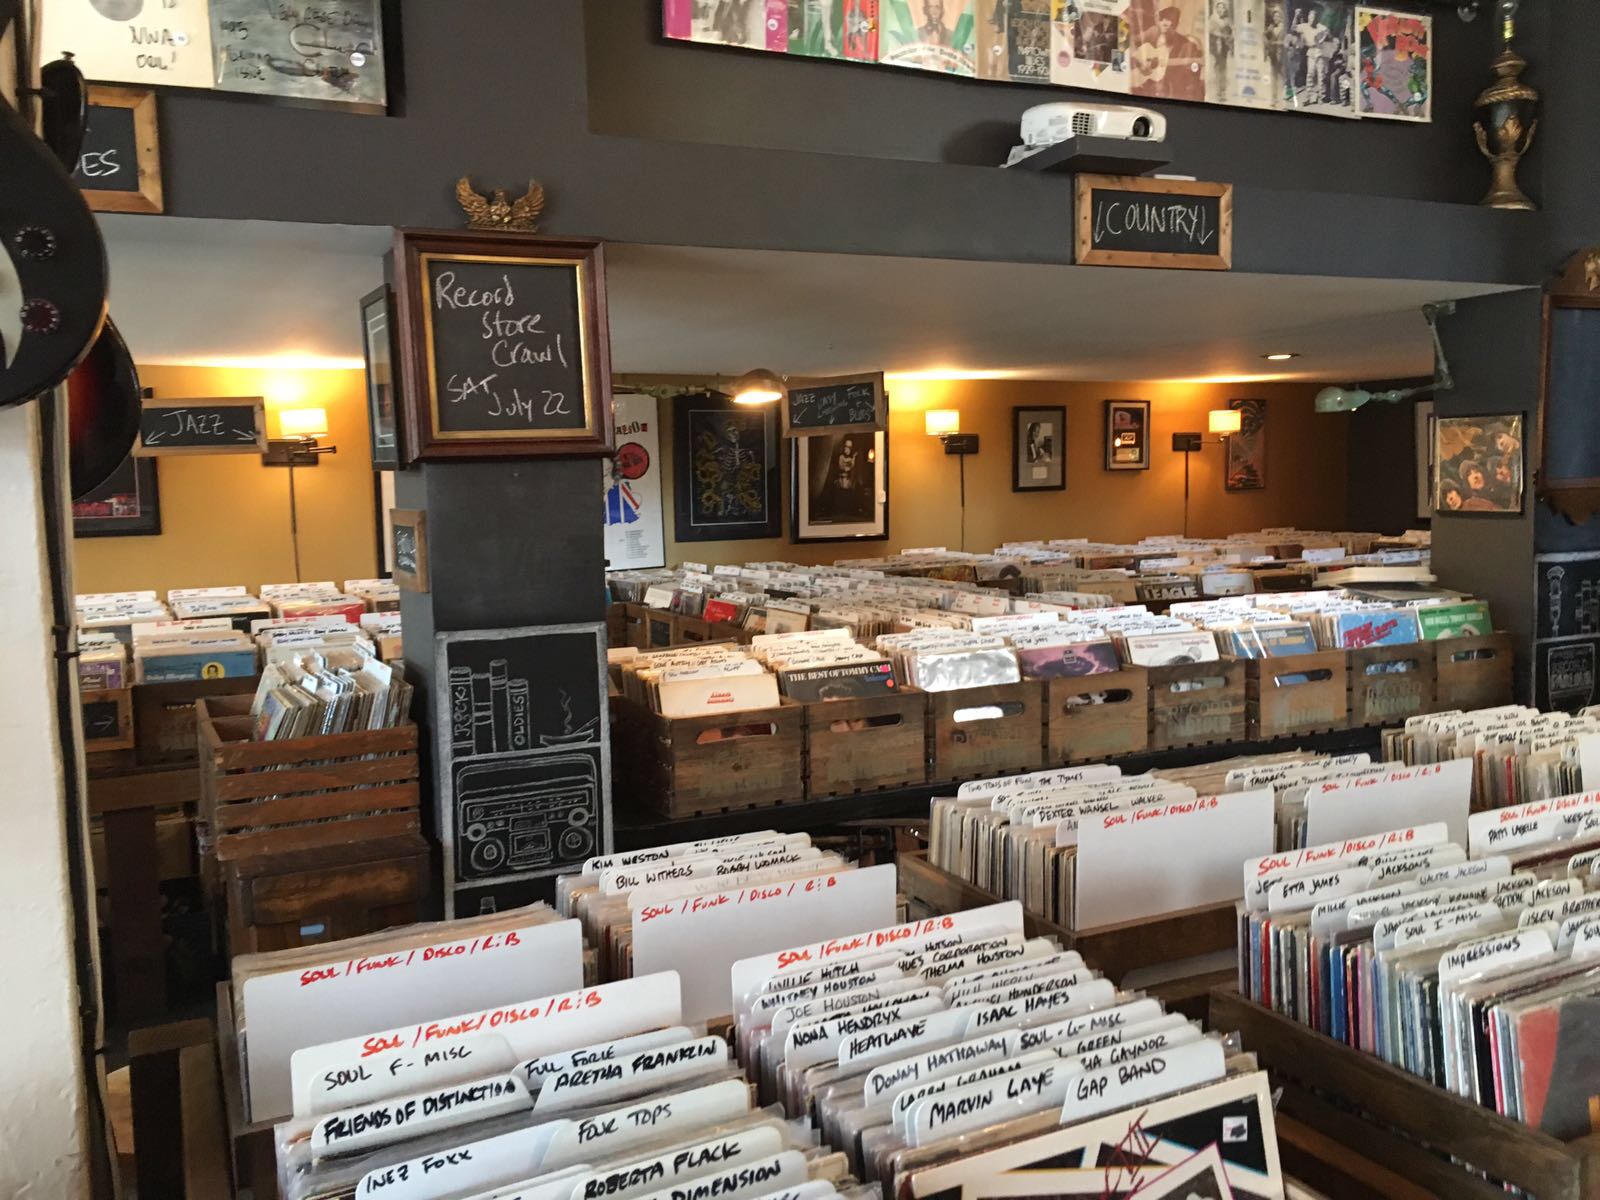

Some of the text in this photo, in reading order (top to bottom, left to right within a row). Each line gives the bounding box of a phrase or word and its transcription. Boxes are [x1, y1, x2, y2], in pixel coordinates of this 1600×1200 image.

[73, 149, 120, 177] ES
[1106, 201, 1198, 242] COUNTRY
[435, 271, 515, 309] Record
[492, 333, 569, 368] Crawl
[488, 388, 571, 423] July 22
[162, 409, 226, 438] JAZZ
[1144, 585, 1198, 600] LEAGUE
[788, 664, 891, 682] THE BEST OF TOMMY CA
[513, 695, 526, 746] OLDIES
[1039, 802, 1119, 823] DEXTER WANSEL
[591, 849, 670, 871] KIM WESTON
[1257, 858, 1292, 877] SOUL
[1305, 849, 1336, 863] FUNK
[1346, 839, 1376, 853] DISCO
[1377, 858, 1432, 880] JACKSONS
[1453, 864, 1488, 881] JACKSON
[615, 864, 693, 889] BILL WITHERS
[1282, 882, 1305, 898] ETTA
[1308, 873, 1340, 894] JAMES
[640, 904, 674, 922] SOUL
[691, 895, 730, 912] FUNK
[749, 885, 782, 902] DISCO
[1318, 901, 1346, 916] MILLIE
[1529, 883, 1571, 907] JACKSON
[1404, 924, 1427, 940] SOUL
[1526, 909, 1555, 926] ISLEY
[777, 951, 812, 969] SOUL
[825, 939, 866, 957] FUNK
[875, 926, 911, 947] DISCO
[924, 933, 963, 953] HUTSON
[932, 937, 1008, 963] CORPORATION
[1447, 936, 1521, 969] IMPRESSIONS
[300, 966, 342, 987] SOUL
[356, 956, 404, 974] FUNK
[422, 945, 466, 962] DISCO
[921, 944, 1025, 980] THELMA HOUSTON
[823, 972, 877, 994] HOUSTON
[786, 1004, 813, 1023] JOE
[823, 988, 881, 1012] HOUSTON
[976, 1005, 1017, 1026] ISAAC
[1024, 992, 1071, 1013] HAYES
[360, 1032, 405, 1058] SOUL
[424, 1020, 476, 1042] FUNK
[489, 1007, 540, 1027] DISCO
[792, 1024, 828, 1049] NONA
[837, 1008, 902, 1035] HENDRYX
[848, 1019, 928, 1060] HEATWAVE
[1019, 1028, 1053, 1050] SOUL
[1090, 1012, 1126, 1031] MISC
[1077, 1030, 1122, 1055] GREEN
[524, 1045, 616, 1080] FULL FORCE
[553, 1040, 717, 1092] ARETHA FRANKLIN
[872, 1037, 1008, 1095] DONNY HATHAWAY
[1110, 1035, 1168, 1064] GAYNOR
[324, 1065, 372, 1091] SOUL
[424, 1046, 472, 1067] MISC
[1077, 1078, 1109, 1102] GAP
[1118, 1057, 1167, 1084] BAND
[929, 1066, 1055, 1128] MARVIN GAYE
[323, 1107, 392, 1144] FRIENDS
[396, 1101, 416, 1125] OF
[578, 1102, 673, 1144] FOUR TOPS
[366, 1149, 473, 1193] INEZ FOXX
[584, 1141, 742, 1200] ROBERTA FLACK
[671, 1158, 782, 1200] DIMENSION
